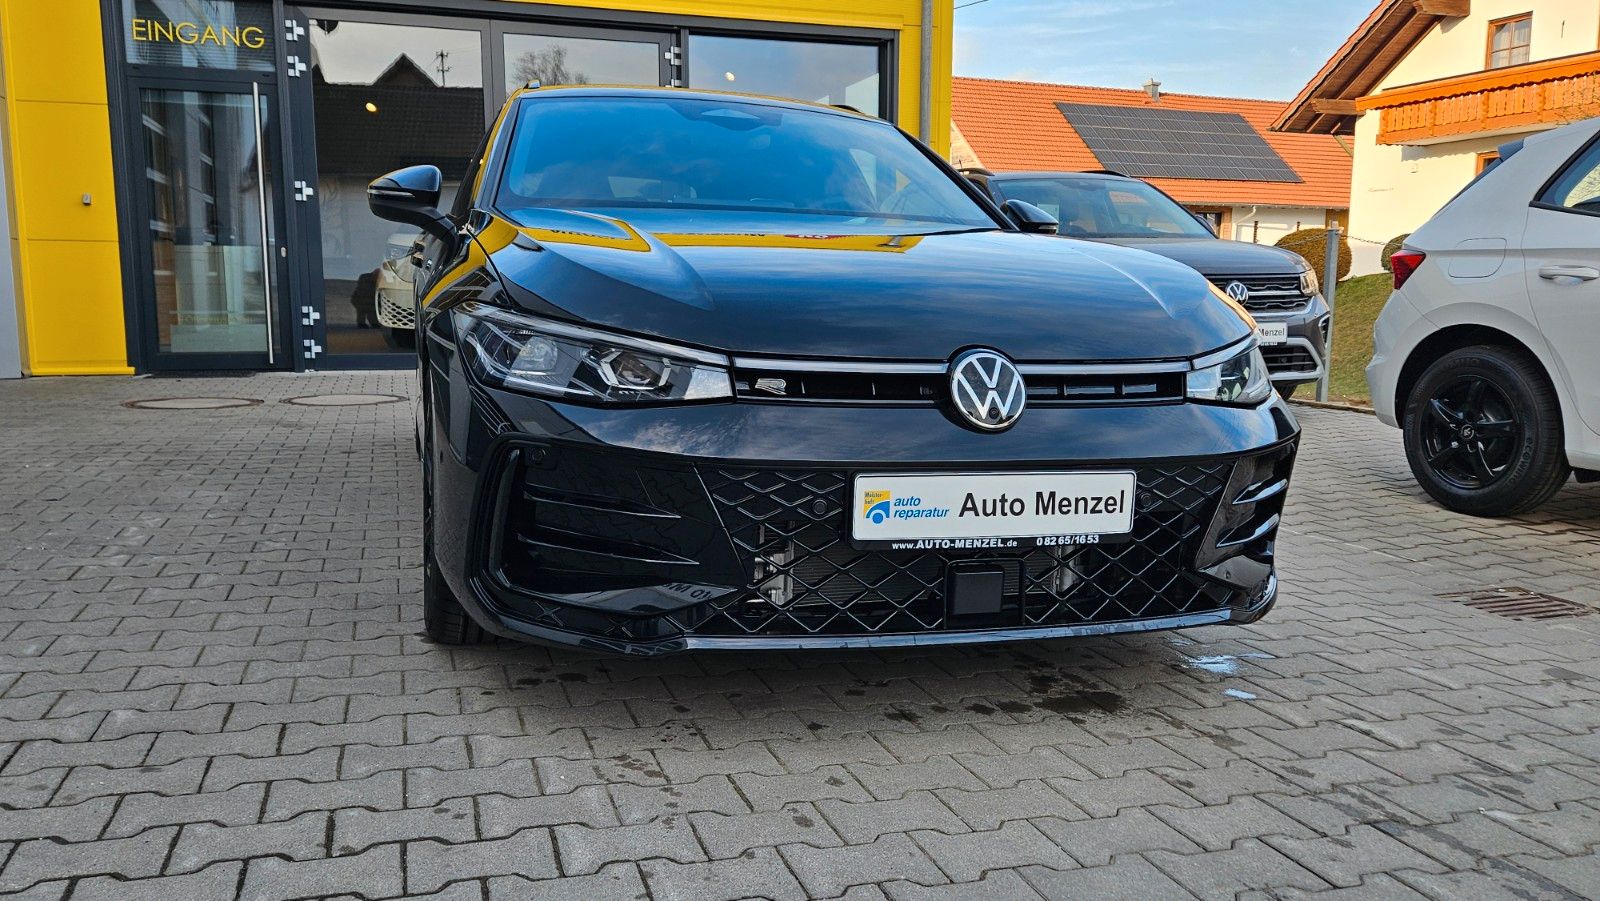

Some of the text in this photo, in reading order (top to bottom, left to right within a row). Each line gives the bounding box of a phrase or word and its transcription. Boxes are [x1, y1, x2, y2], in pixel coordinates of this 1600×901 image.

[131, 18, 266, 49] EINGANG
[893, 496, 921, 507] auto
[958, 490, 1126, 518] Auto Menzel
[893, 507, 950, 520] reparatur
[892, 538, 1018, 550] www.AUTO-MENZEL.de
